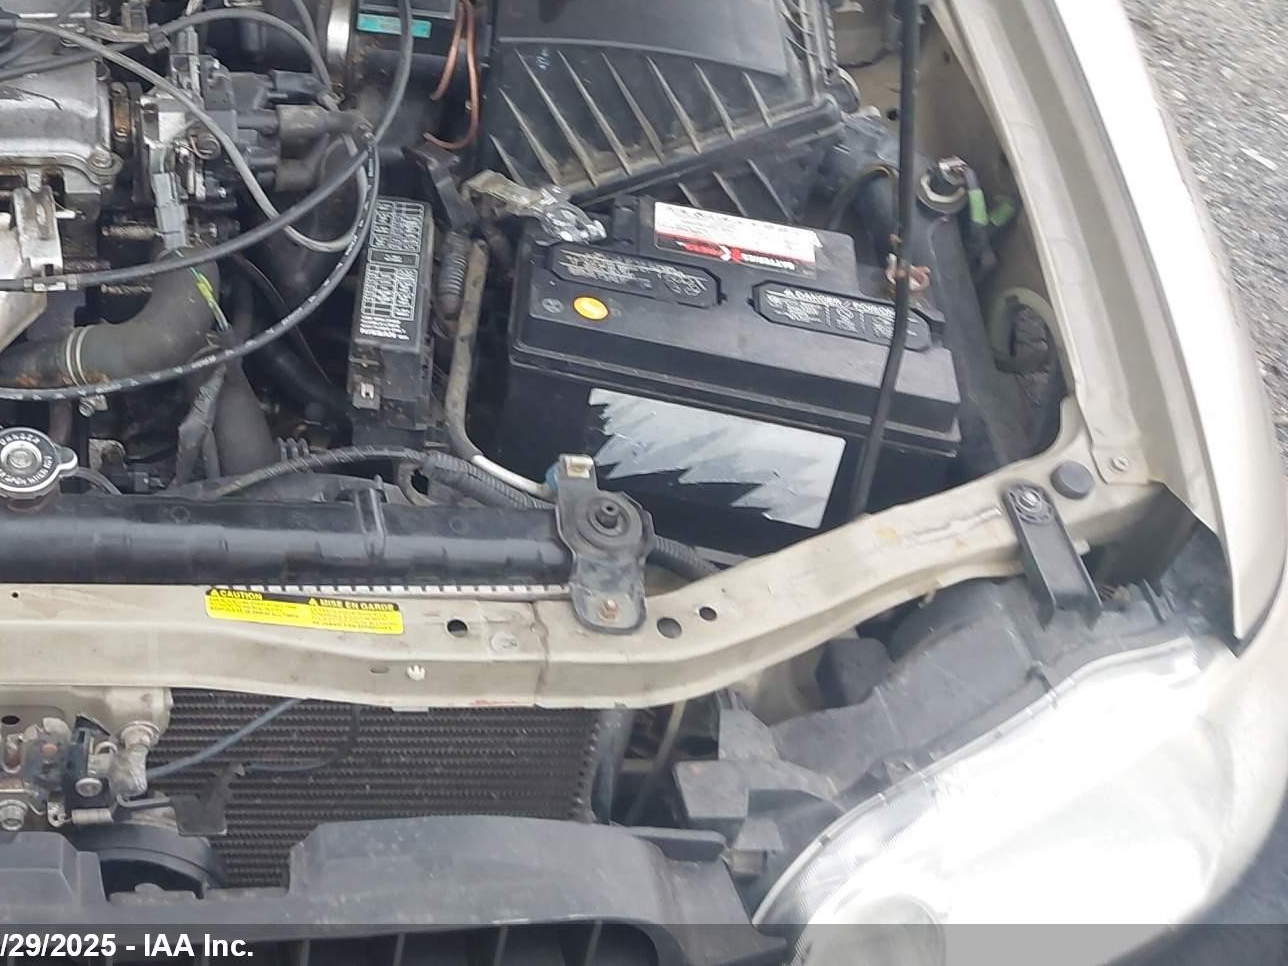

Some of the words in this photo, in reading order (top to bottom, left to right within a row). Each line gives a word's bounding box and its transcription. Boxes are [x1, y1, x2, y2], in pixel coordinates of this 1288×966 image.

[220, 590, 263, 601] CAUTION
[319, 598, 343, 608] MISE
[344, 601, 359, 610] EN
